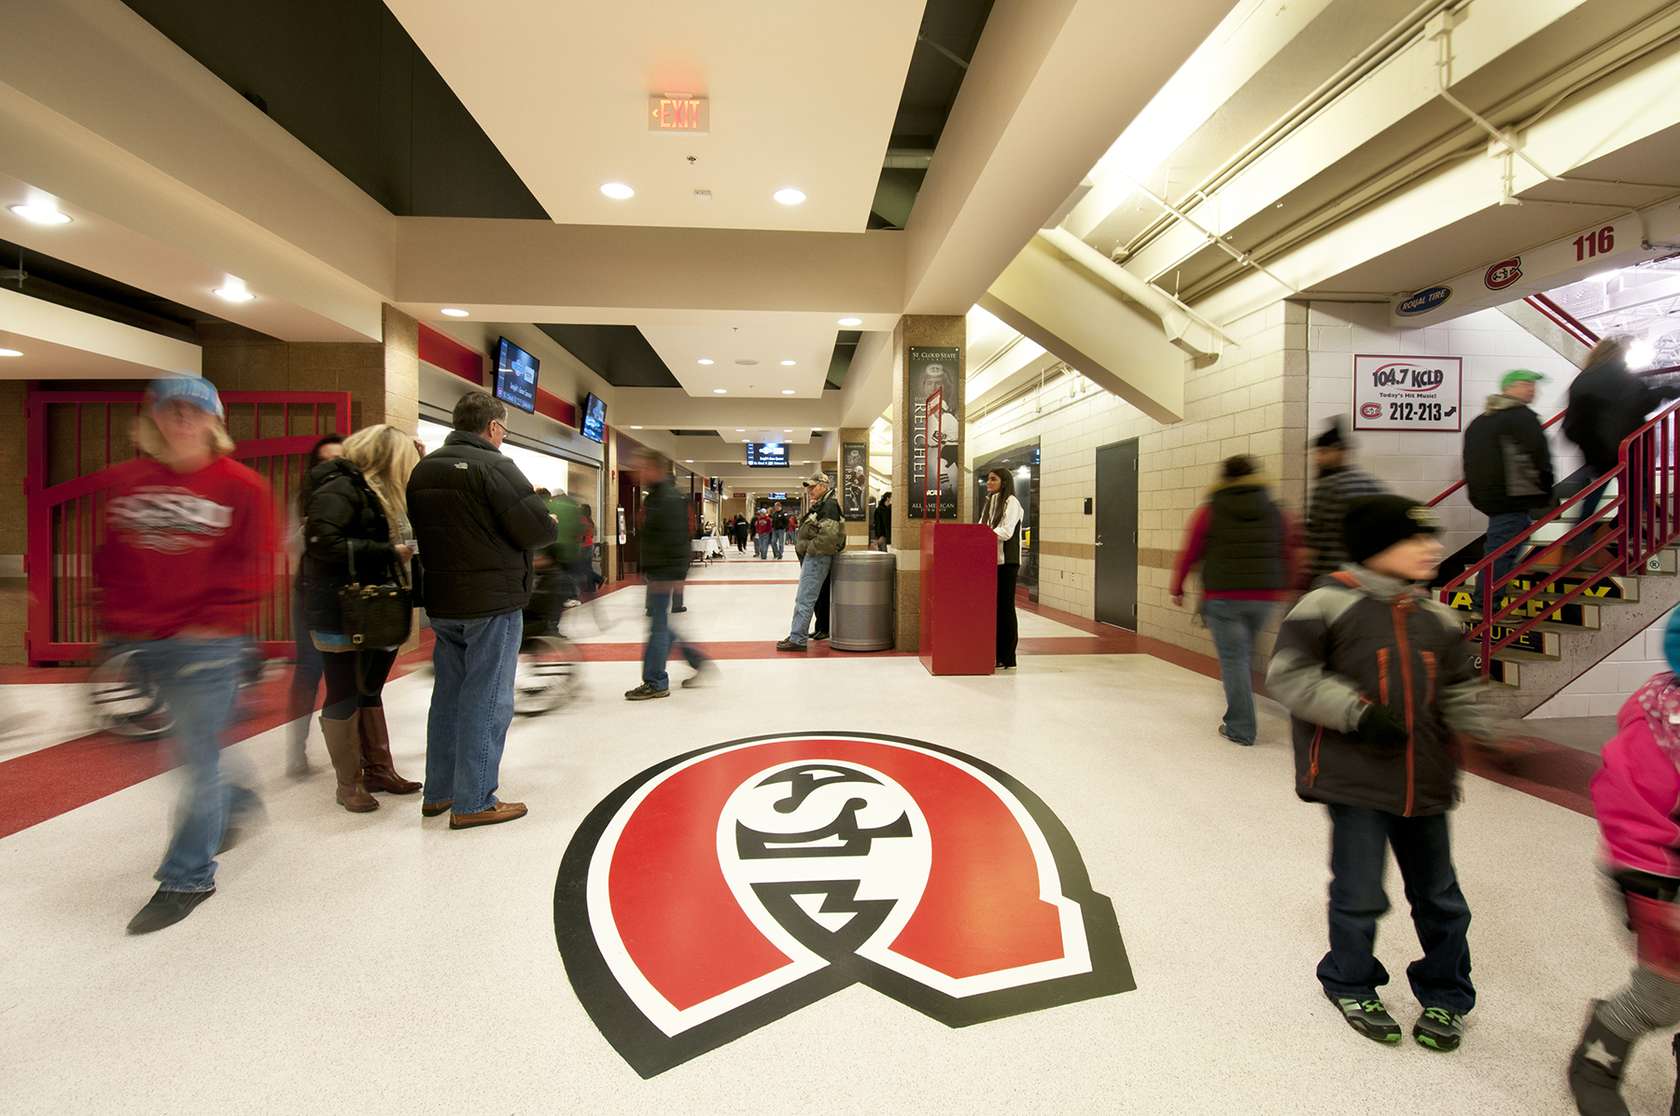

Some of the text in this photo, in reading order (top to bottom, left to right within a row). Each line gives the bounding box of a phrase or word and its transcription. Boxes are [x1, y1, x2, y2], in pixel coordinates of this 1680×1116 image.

[660, 99, 700, 129] EXIT
[1573, 225, 1615, 261] 116
[1401, 296, 1425, 311] ROYAL
[1372, 368, 1444, 388] 104.7 KCLD
[1390, 402, 1442, 421] 212-213
[914, 403, 926, 484] REICHEL
